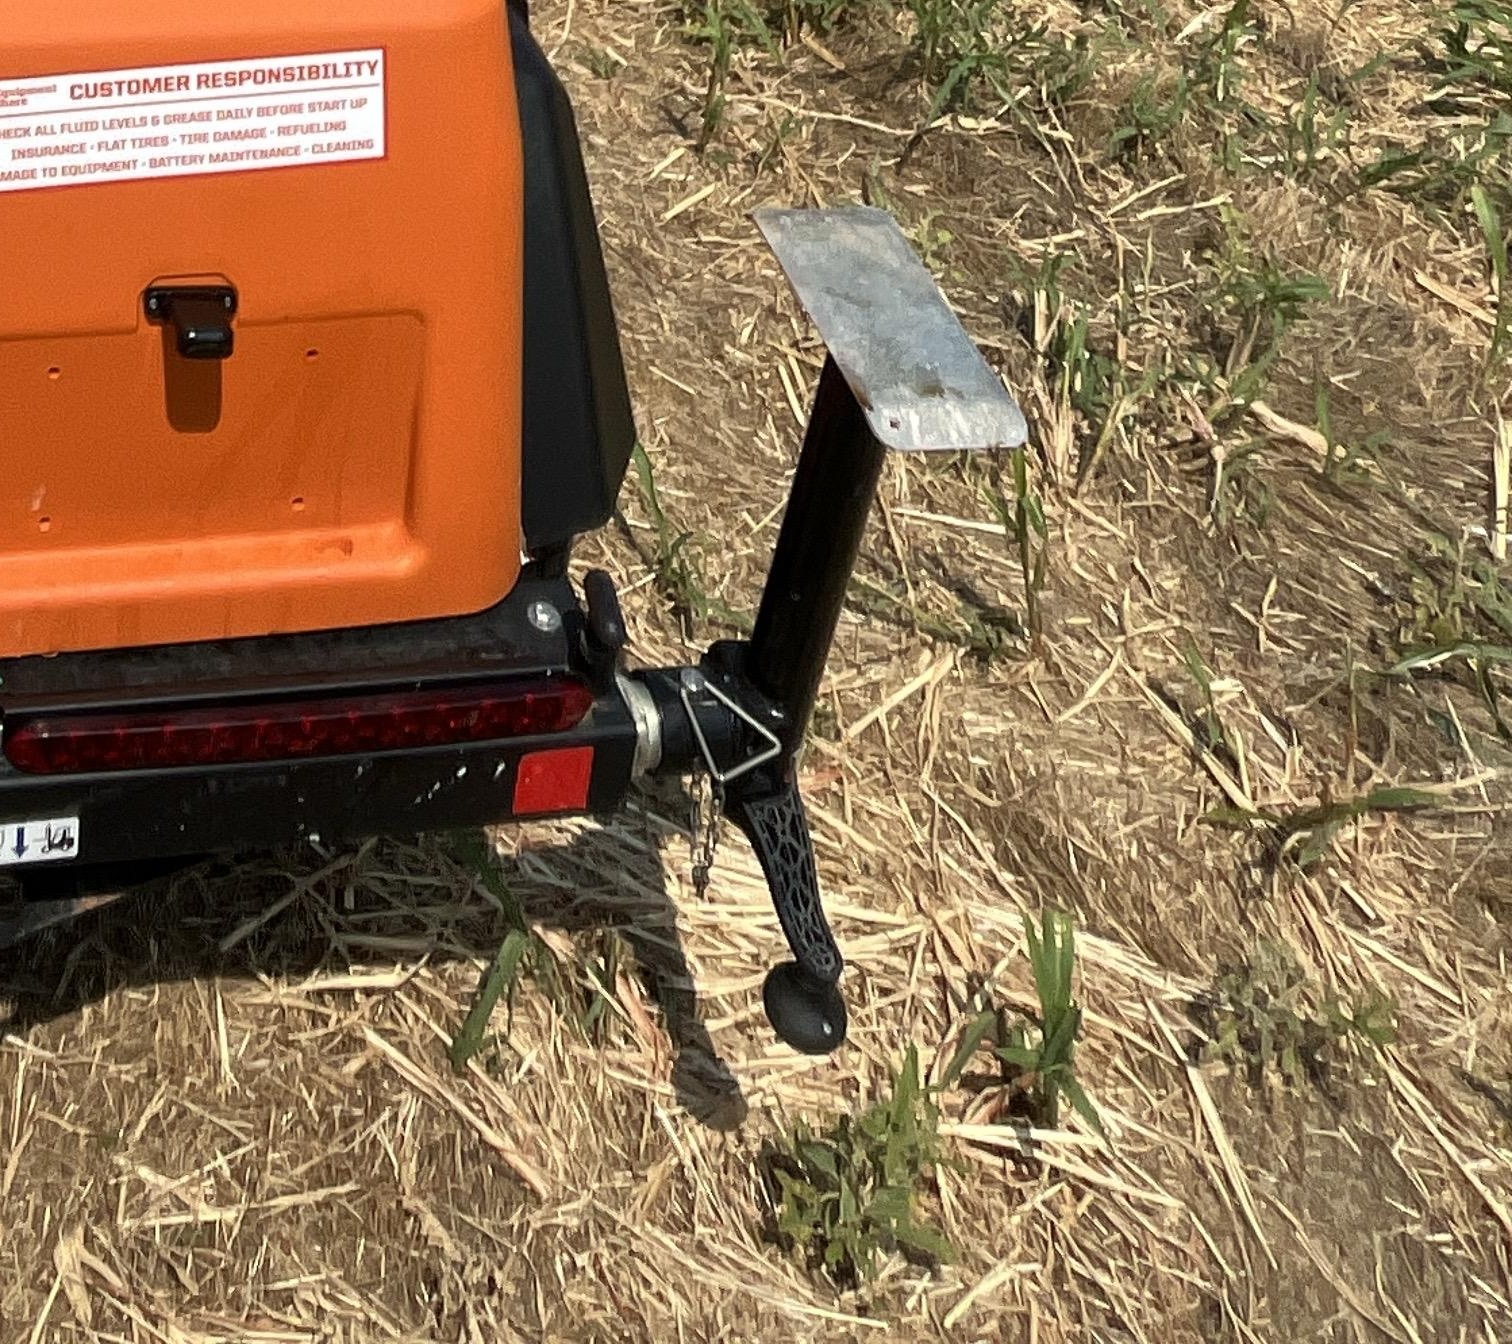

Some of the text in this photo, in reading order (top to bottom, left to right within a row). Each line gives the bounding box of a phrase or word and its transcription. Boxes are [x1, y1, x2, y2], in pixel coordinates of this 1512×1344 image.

[69, 59, 379, 100] CUSTOMER RESPONSIBILITY
[35, 123, 57, 137] ALL
[60, 121, 99, 135] FLUID
[101, 116, 148, 131] LEVELS
[163, 110, 213, 125] GREASE
[216, 107, 254, 121] DAILY
[256, 103, 305, 118] BEFORE
[307, 99, 348, 113] START
[350, 97, 369, 110] UP
[11, 120, 348, 161] INSURANCE FLAT TIRES TIRE DAMAGE REFUELING
[42, 166, 58, 178] TO
[61, 159, 139, 176] EQUIPMENT
[148, 154, 206, 169] BATTERY
[208, 145, 302, 163] MAINTENANCE
[311, 138, 375, 154] CLEANING
